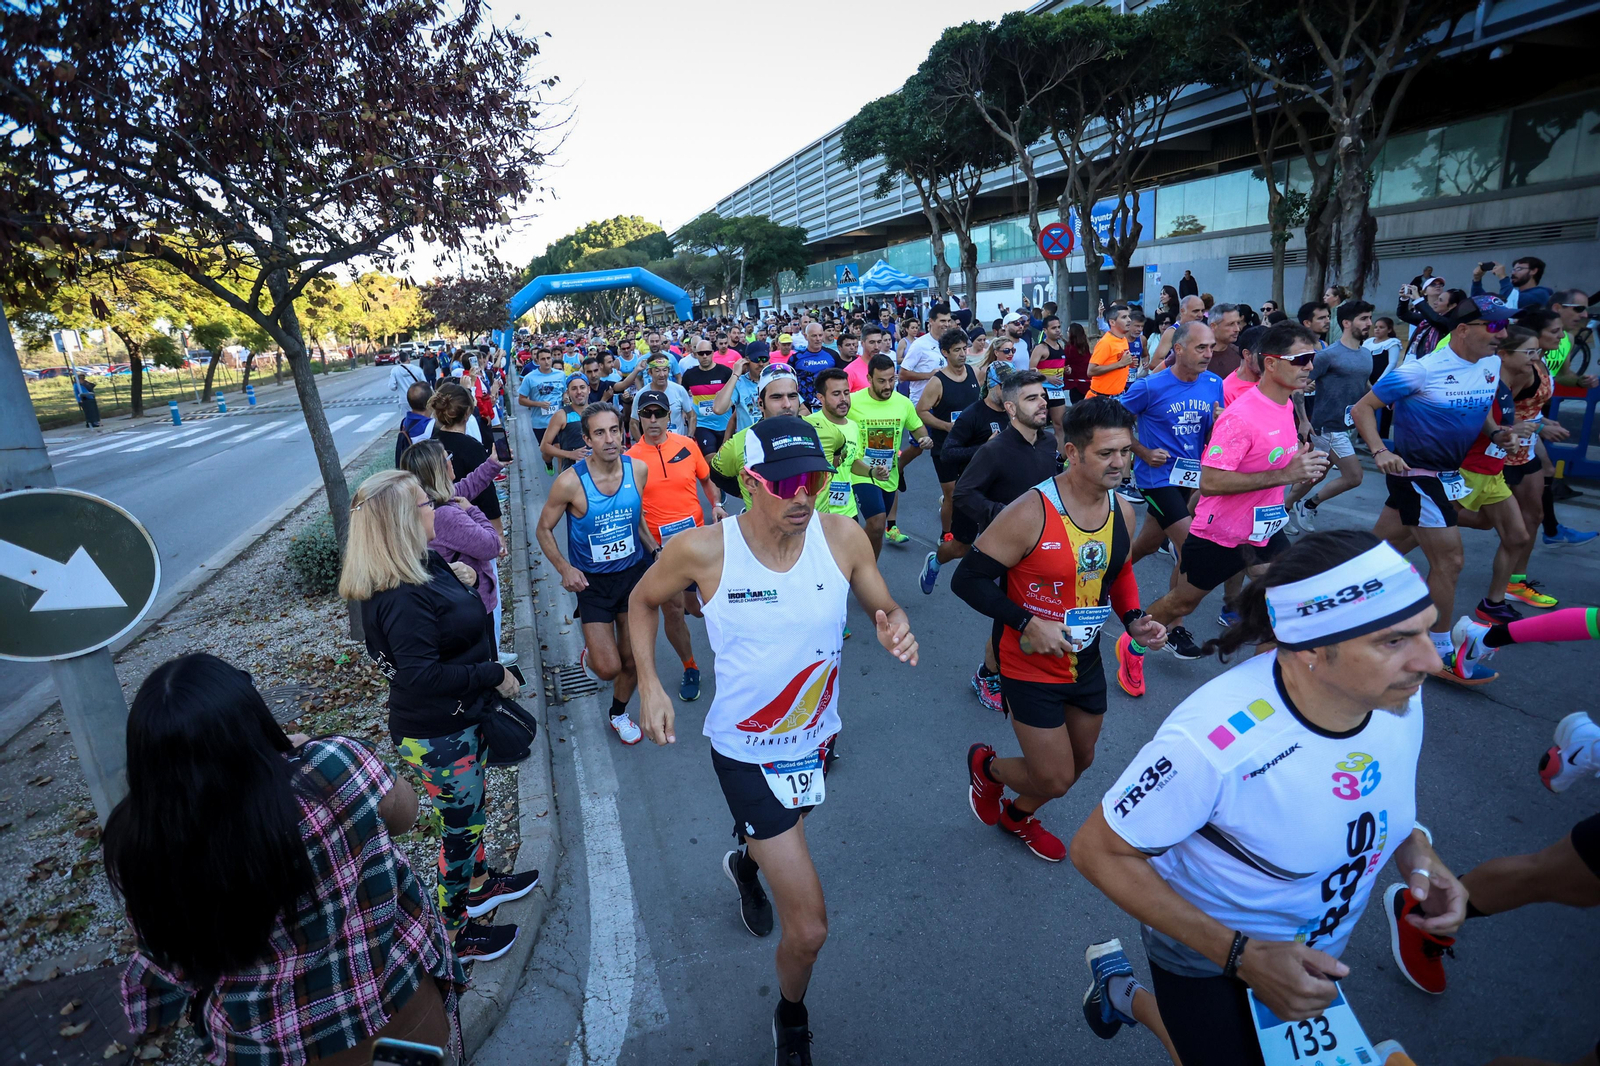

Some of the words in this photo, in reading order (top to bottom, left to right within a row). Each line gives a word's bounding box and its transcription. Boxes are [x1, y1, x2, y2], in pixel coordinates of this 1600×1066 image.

[1170, 401, 1185, 414] HOY
[1172, 424, 1201, 436] TODO
[1183, 471, 1198, 482] 82
[829, 491, 845, 501] 742
[1264, 520, 1281, 534] 719
[602, 540, 627, 555] 245
[763, 589, 778, 597] 70.3
[1296, 578, 1384, 617] TR3S
[745, 734, 798, 747] SPANISH
[777, 761, 796, 769] Ciudad
[1242, 742, 1303, 782] FIREHAWK
[1113, 755, 1173, 819] TR3S
[1364, 809, 1388, 877] TRAILS
[1284, 1015, 1338, 1061] 133
